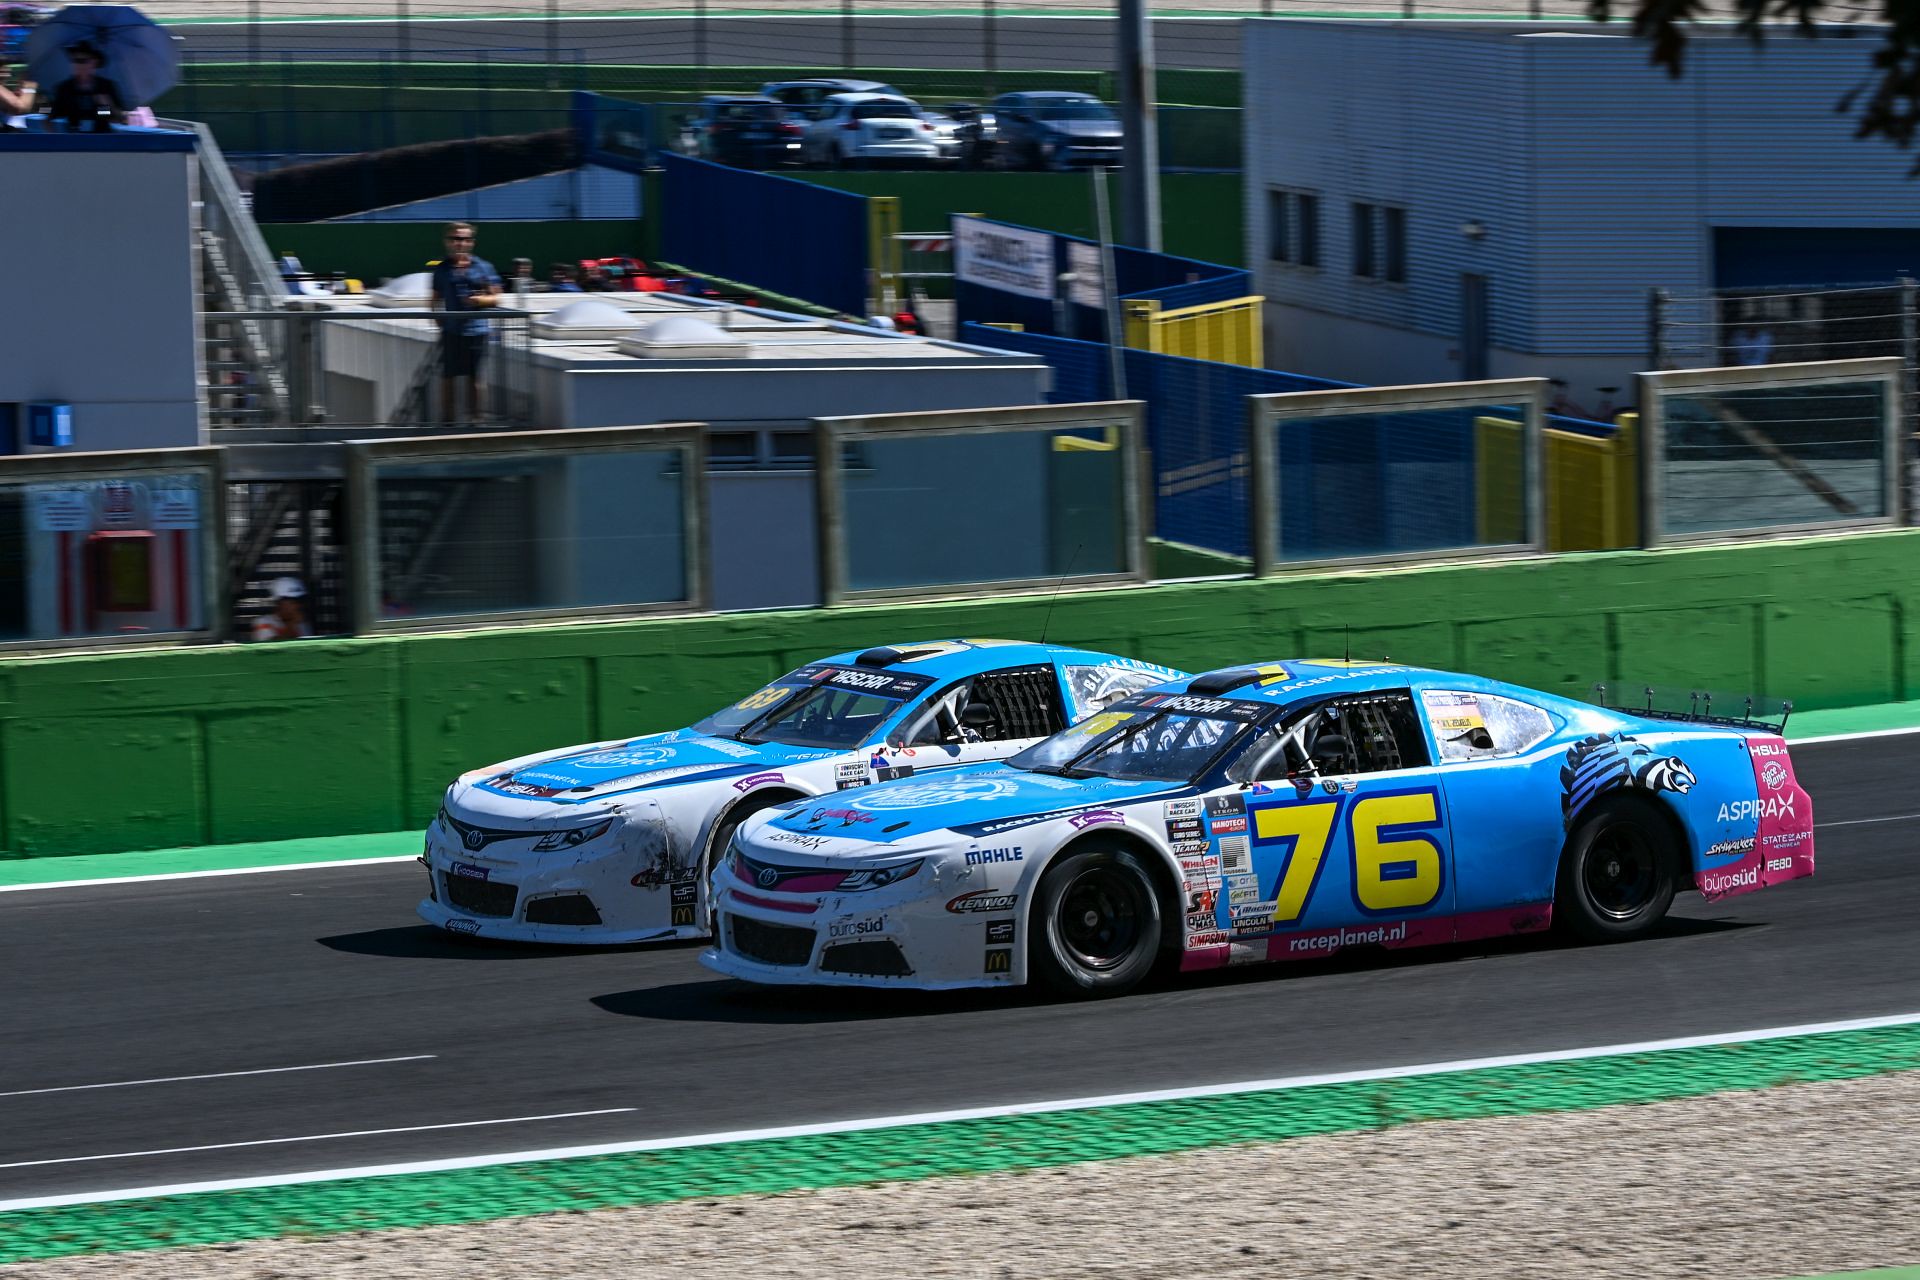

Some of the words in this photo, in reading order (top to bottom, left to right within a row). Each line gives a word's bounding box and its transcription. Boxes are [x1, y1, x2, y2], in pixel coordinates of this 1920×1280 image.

[830, 669, 894, 689] NASCAR
[1154, 694, 1234, 713] NASCAR
[785, 751, 838, 760] FEBO
[1750, 744, 1788, 757] HSU.nl
[1717, 791, 1796, 823] ASPIRAX
[1211, 818, 1246, 829] NANOTECH
[1762, 835, 1788, 845] STATE
[1795, 831, 1812, 840] ART
[964, 846, 1023, 866] MAHLE
[1254, 792, 1441, 922] 76
[1767, 857, 1792, 872] FEBO
[951, 896, 1015, 910] KENNOL
[1233, 917, 1268, 928] LINCOLN
[1188, 933, 1227, 948] SIMPSON
[1290, 921, 1406, 952] raceplanet.nl
